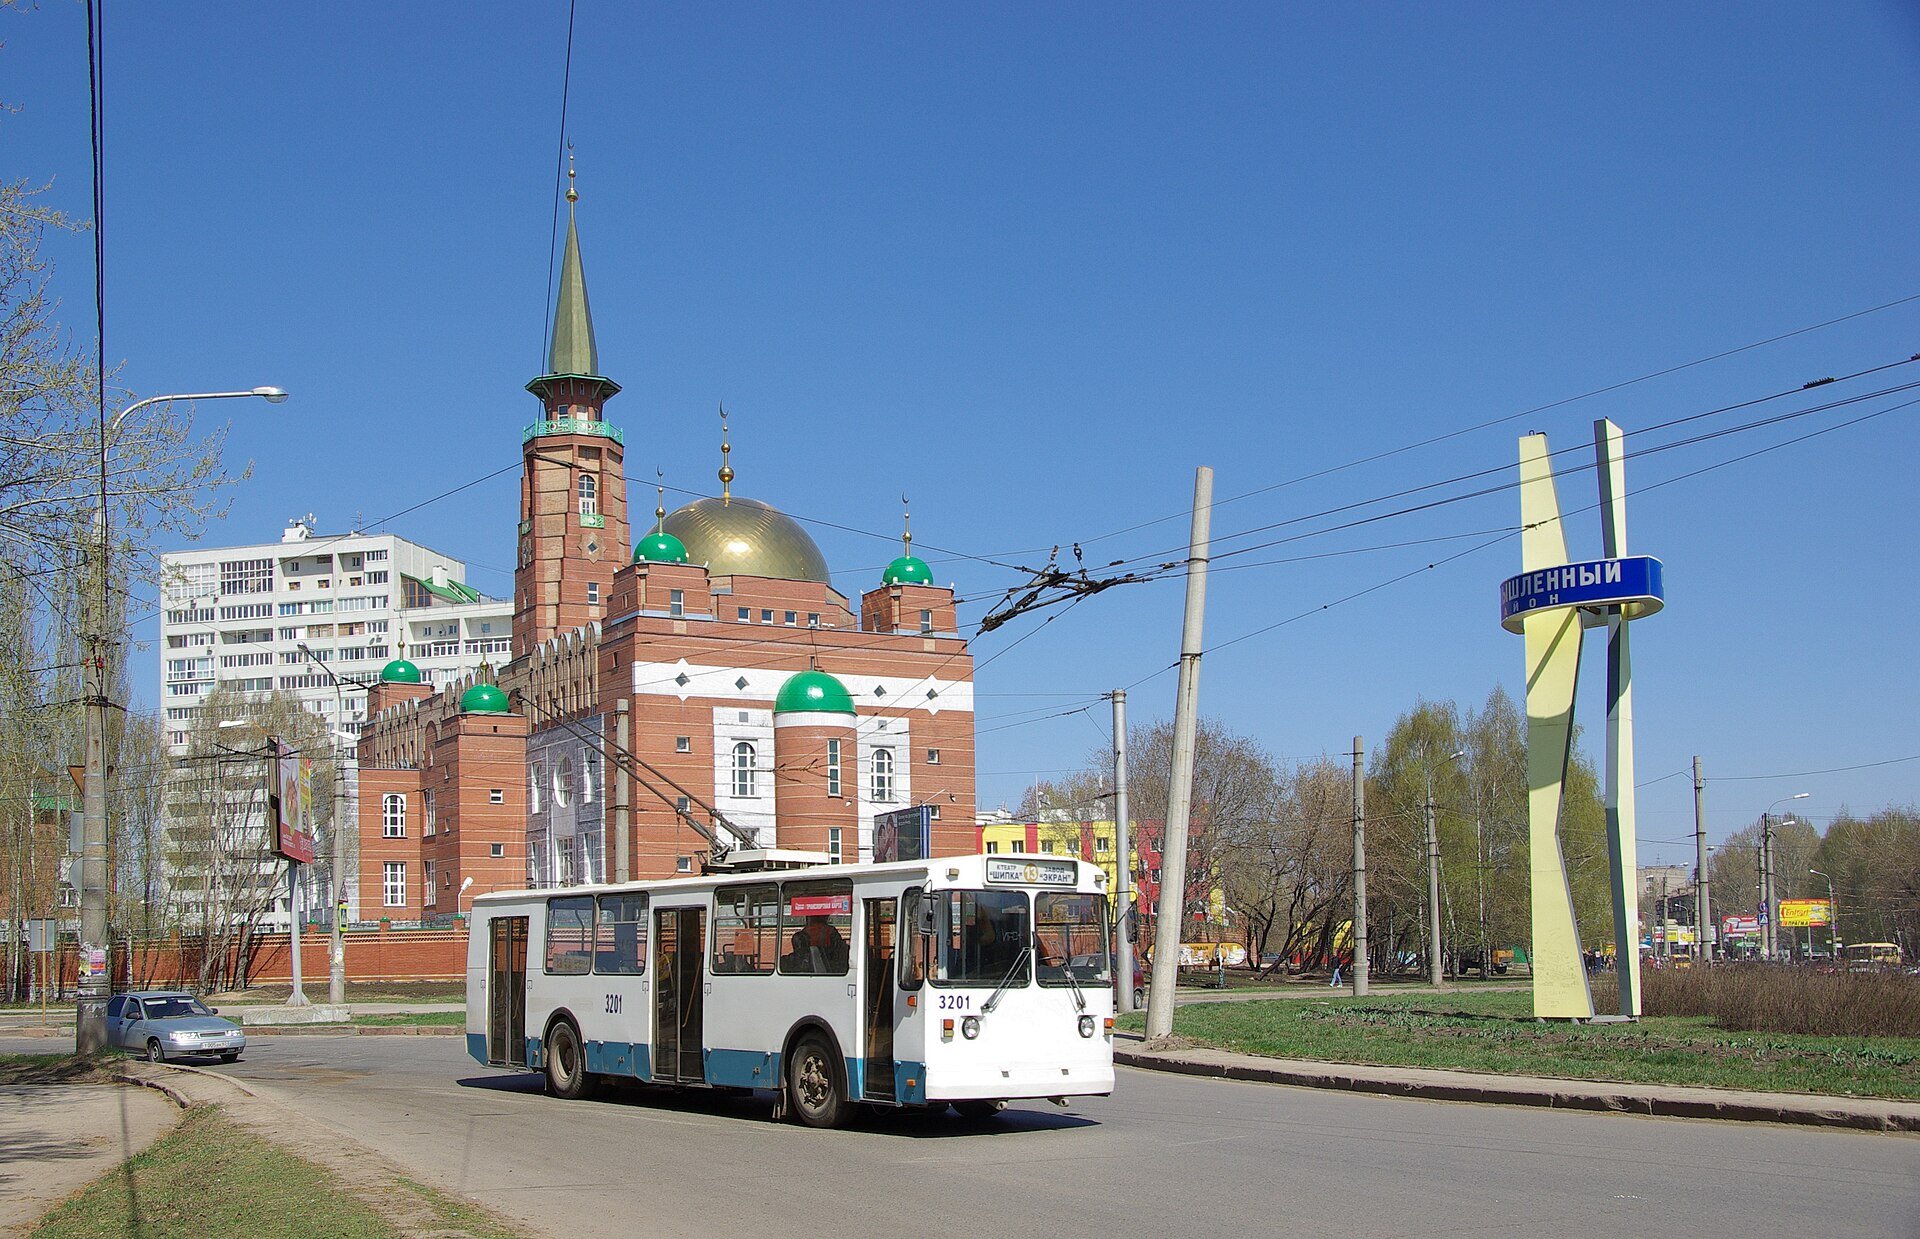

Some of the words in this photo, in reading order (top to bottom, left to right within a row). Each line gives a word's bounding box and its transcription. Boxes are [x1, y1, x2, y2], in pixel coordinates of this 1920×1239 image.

[1025, 866, 1037, 880] 13
[605, 994, 622, 1014] 3201
[938, 995, 970, 1010] 3201
